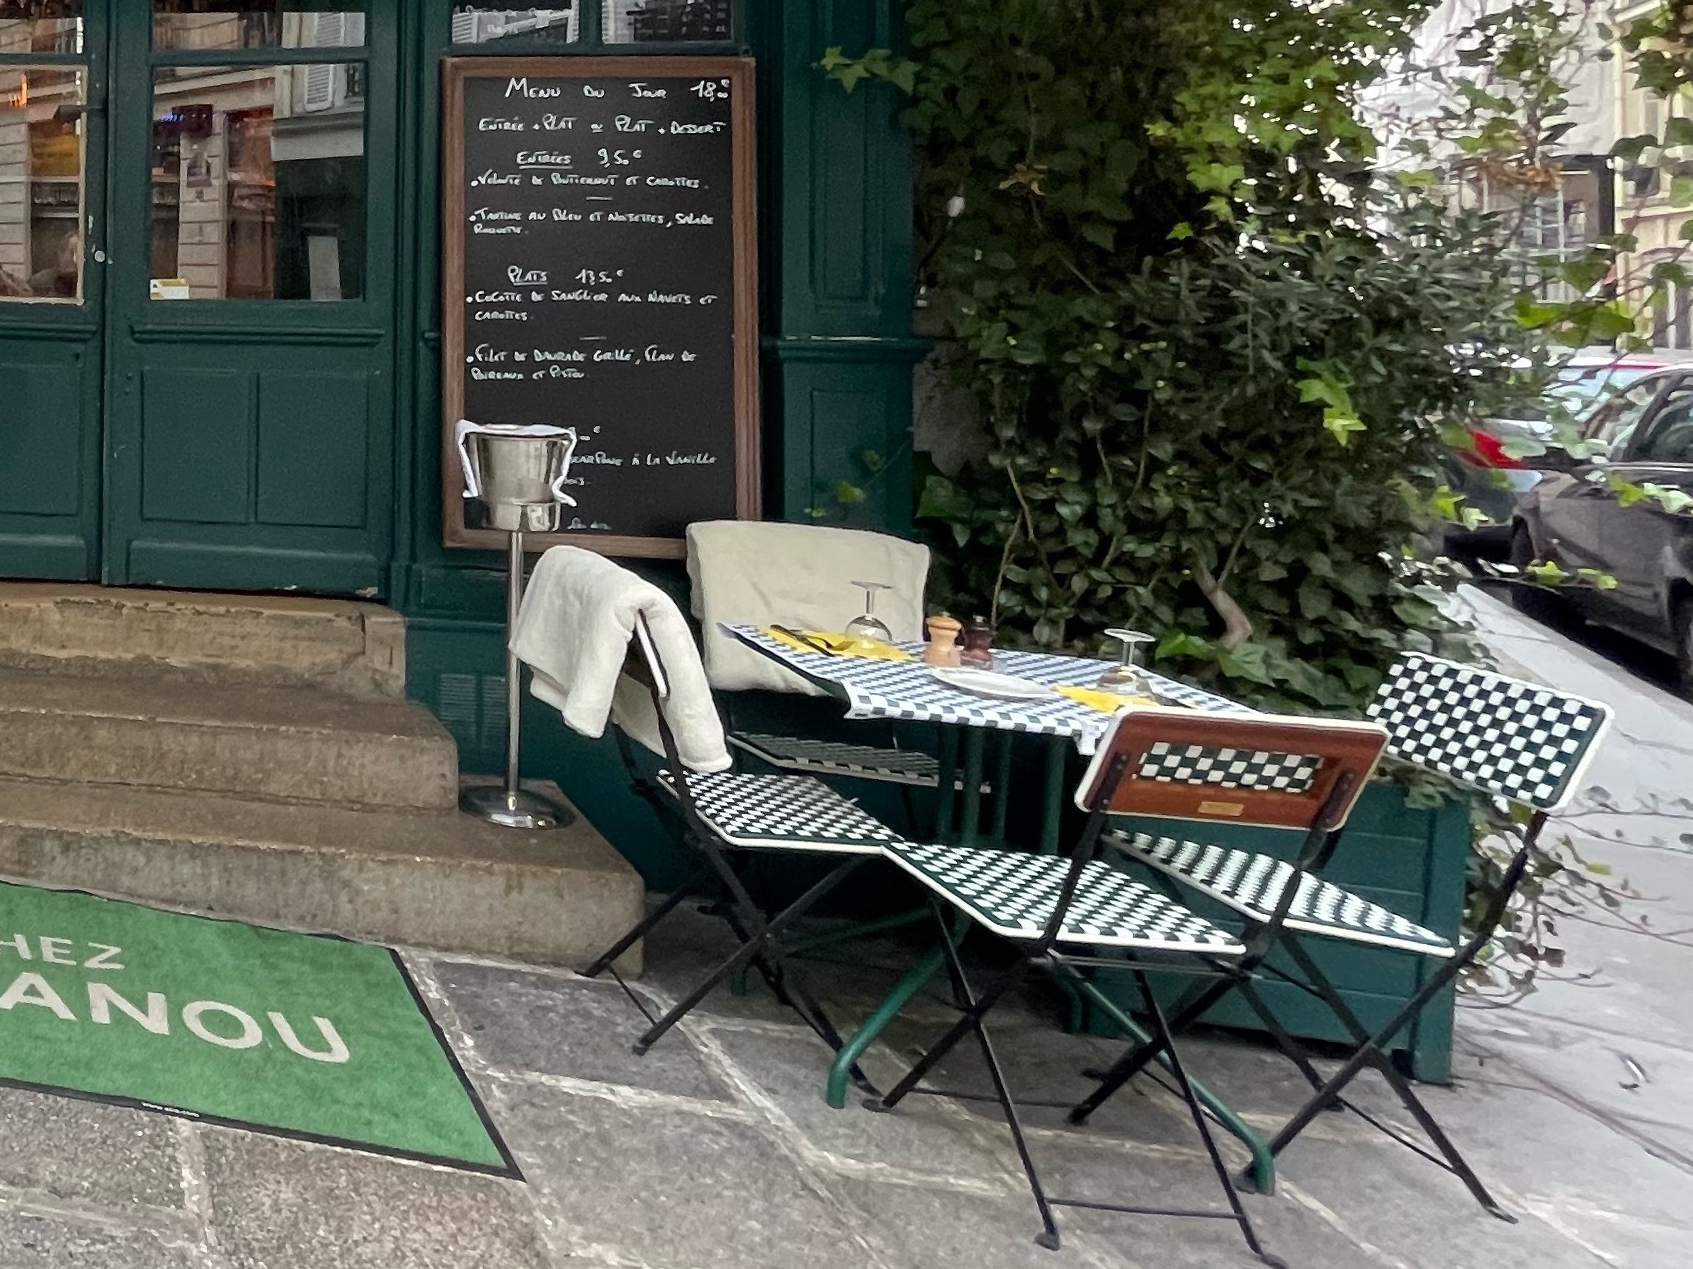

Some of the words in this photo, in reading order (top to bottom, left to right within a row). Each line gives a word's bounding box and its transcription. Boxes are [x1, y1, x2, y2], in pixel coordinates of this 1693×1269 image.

[541, 113, 578, 131] PLAT
[615, 115, 655, 132] PLAT
[507, 265, 548, 282] PLATS
[474, 290, 522, 303] COCOTTE
[647, 290, 692, 305] NAVETS
[475, 343, 508, 362] FILET
